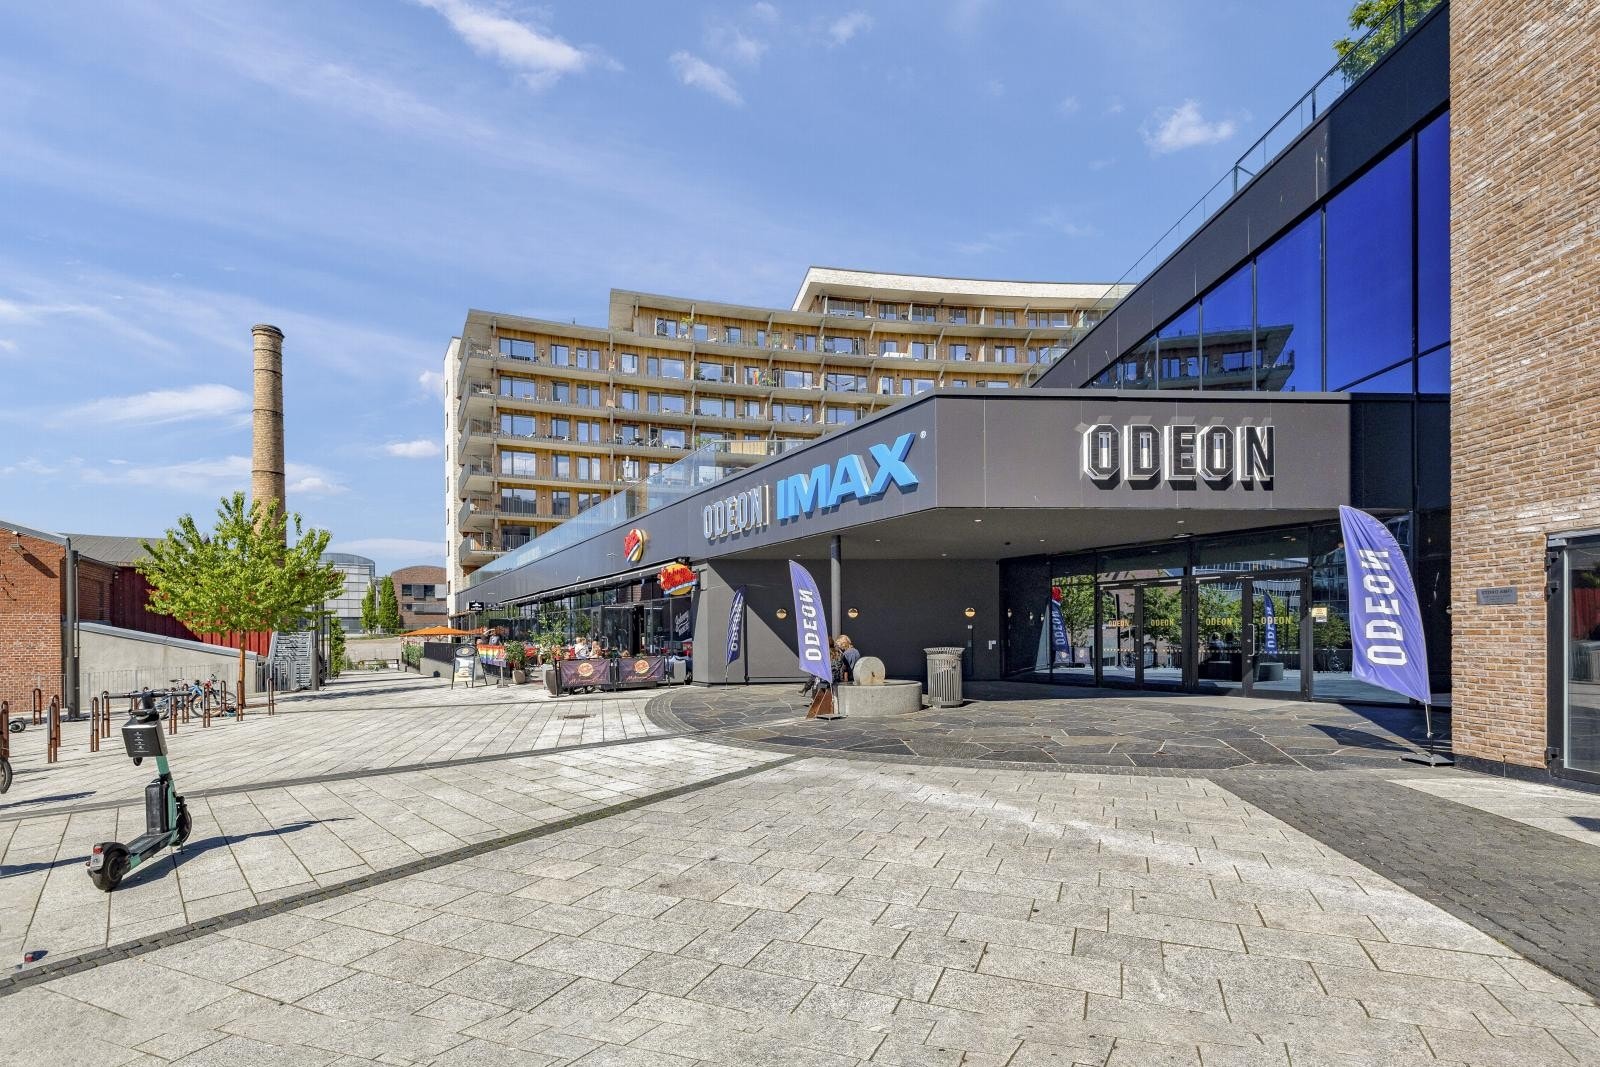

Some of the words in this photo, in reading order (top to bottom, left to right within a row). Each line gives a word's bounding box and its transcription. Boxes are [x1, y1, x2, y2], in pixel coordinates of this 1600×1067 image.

[1083, 424, 1275, 481] ODEON
[703, 485, 764, 541] ODEON
[776, 433, 919, 520] IMAX
[1108, 619, 1131, 628] ODEON
[1150, 618, 1175, 627] ODEON
[1205, 617, 1233, 626] ODEON
[1261, 616, 1292, 625] ODEON
[1359, 549, 1408, 666] ODEON
[798, 588, 822, 661] ODEON
